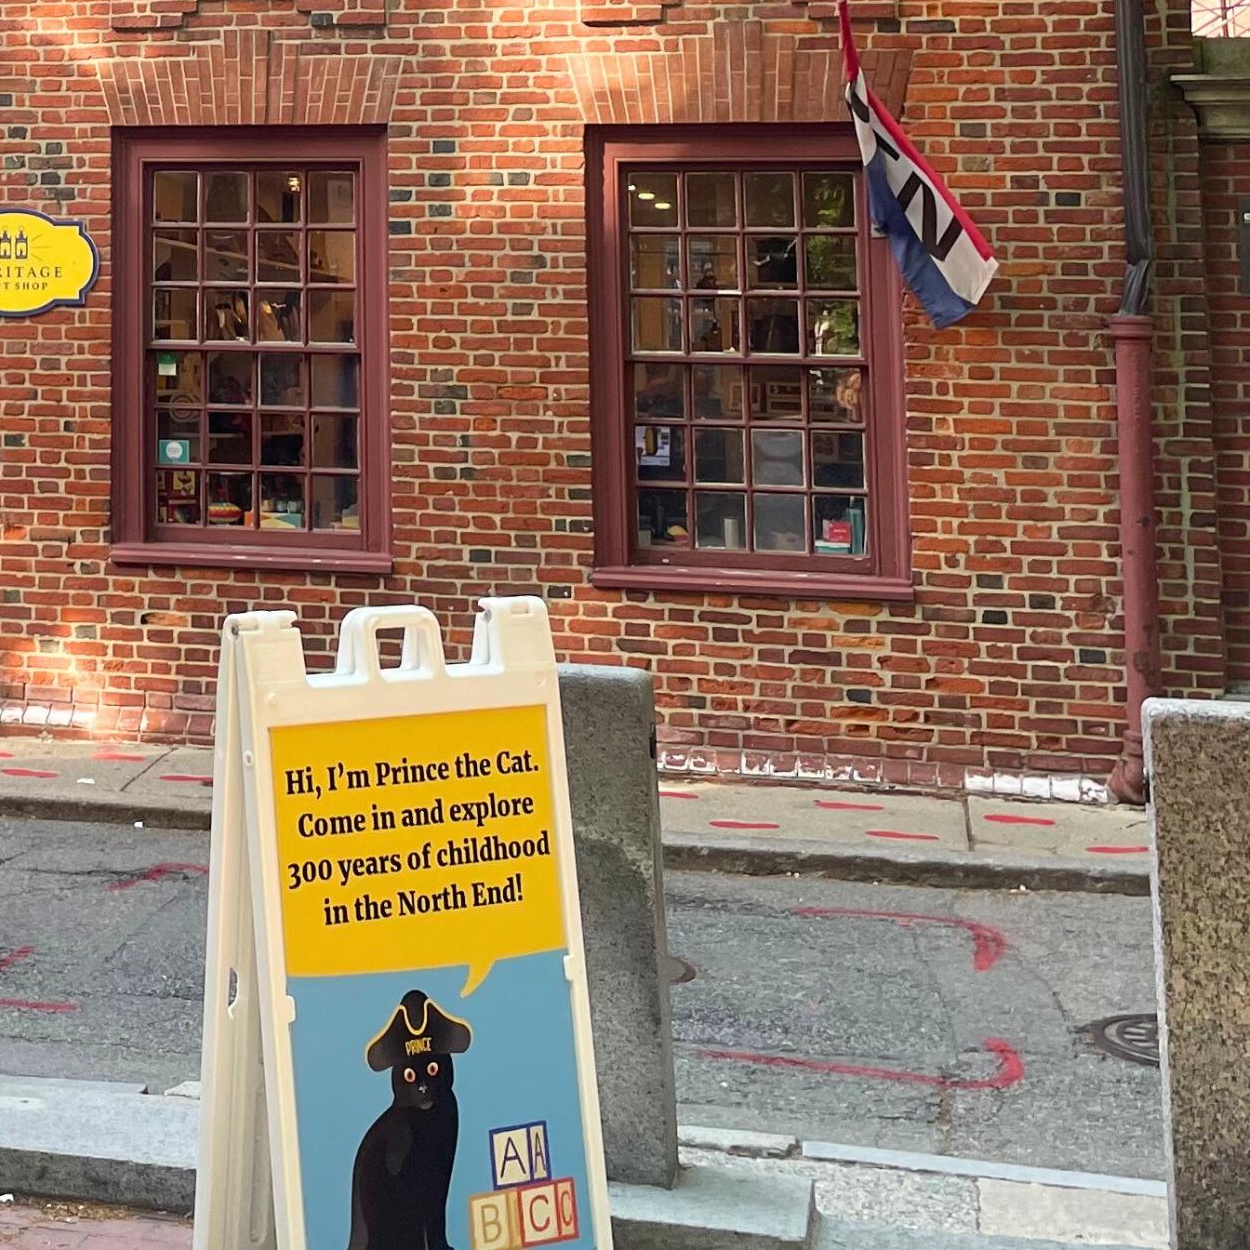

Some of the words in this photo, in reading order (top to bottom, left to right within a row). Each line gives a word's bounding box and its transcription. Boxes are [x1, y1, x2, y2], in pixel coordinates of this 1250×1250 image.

[15, 282, 48, 290] SHOP
[285, 766, 322, 800] Hi,
[327, 762, 371, 791] I'm
[375, 757, 449, 786] Prince
[455, 752, 491, 778] the
[496, 749, 539, 774] Cat.
[298, 813, 366, 838] Come
[372, 803, 396, 831] in
[401, 798, 444, 827] and
[449, 792, 534, 827] explore
[287, 858, 332, 890] 300
[337, 851, 401, 886] years
[407, 842, 432, 870] of
[436, 830, 551, 867] childhood
[324, 897, 349, 926] in
[354, 894, 393, 921] the
[398, 883, 467, 917] North
[471, 873, 524, 907] End!
[405, 1037, 432, 1056] PRINCE
[500, 1136, 527, 1179] A
[534, 1131, 547, 1174] A
[481, 1203, 502, 1244] B
[529, 1194, 550, 1232] C
[560, 1190, 573, 1227] C
